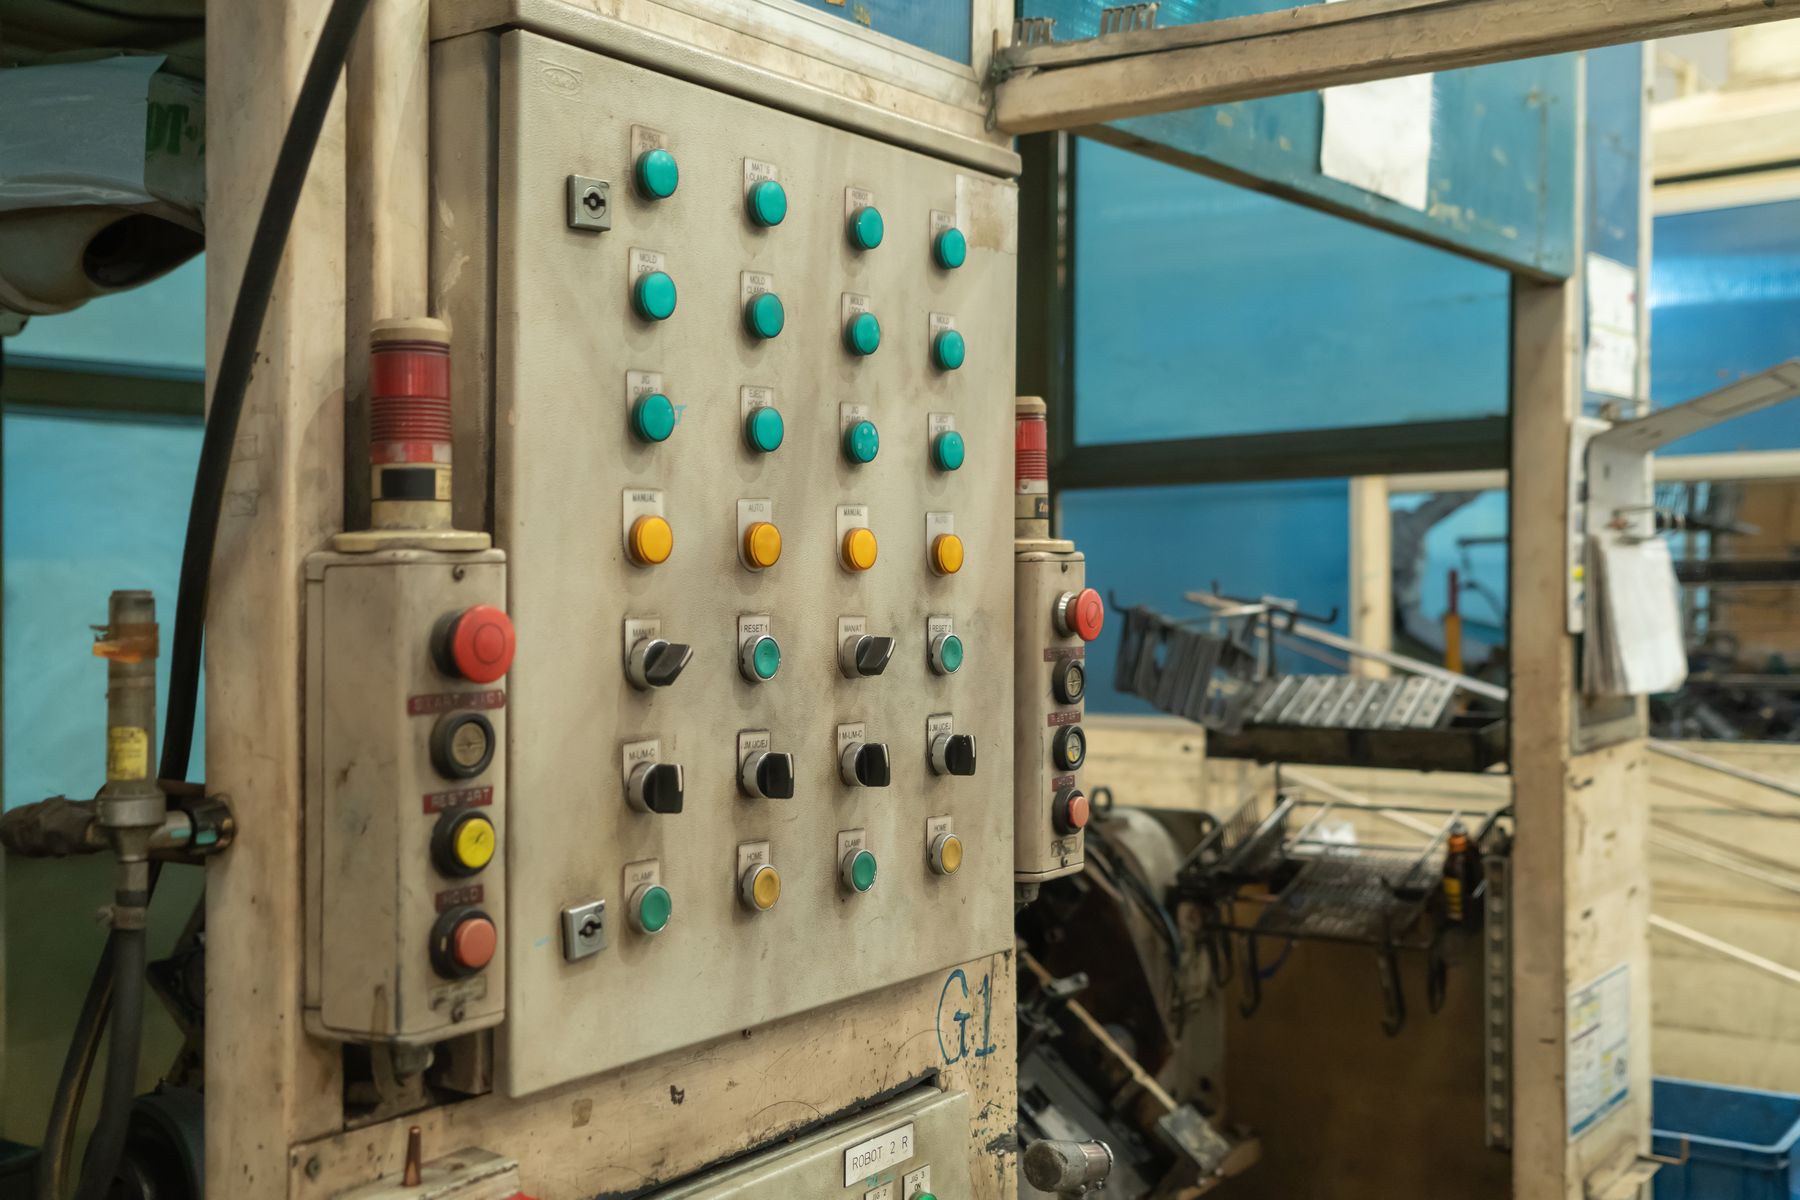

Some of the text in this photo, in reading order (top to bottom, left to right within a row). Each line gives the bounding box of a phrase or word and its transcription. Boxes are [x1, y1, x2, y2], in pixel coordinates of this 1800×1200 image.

[640, 253, 657, 264] MOLD
[749, 275, 765, 285] MOLD
[850, 296, 864, 306] MOLD
[936, 315, 949, 325] MOLD
[749, 388, 766, 399] EJECT
[632, 492, 657, 503] MANUAL
[748, 503, 764, 513] AUTO
[843, 508, 862, 516] MANUAL
[743, 624, 763, 633] RESET
[932, 624, 947, 632] RESET
[431, 788, 491, 809] RESTART
[934, 823, 947, 832] HOME
[845, 838, 861, 848] CLAMP
[747, 850, 763, 861] HOME
[632, 870, 654, 882] CLAMP
[441, 886, 480, 904] HOLD
[937, 969, 997, 1065] G1
[852, 1135, 908, 1171] ROBOT 2 R
[910, 1174, 918, 1184] JIG
[914, 1181, 922, 1191] ON
